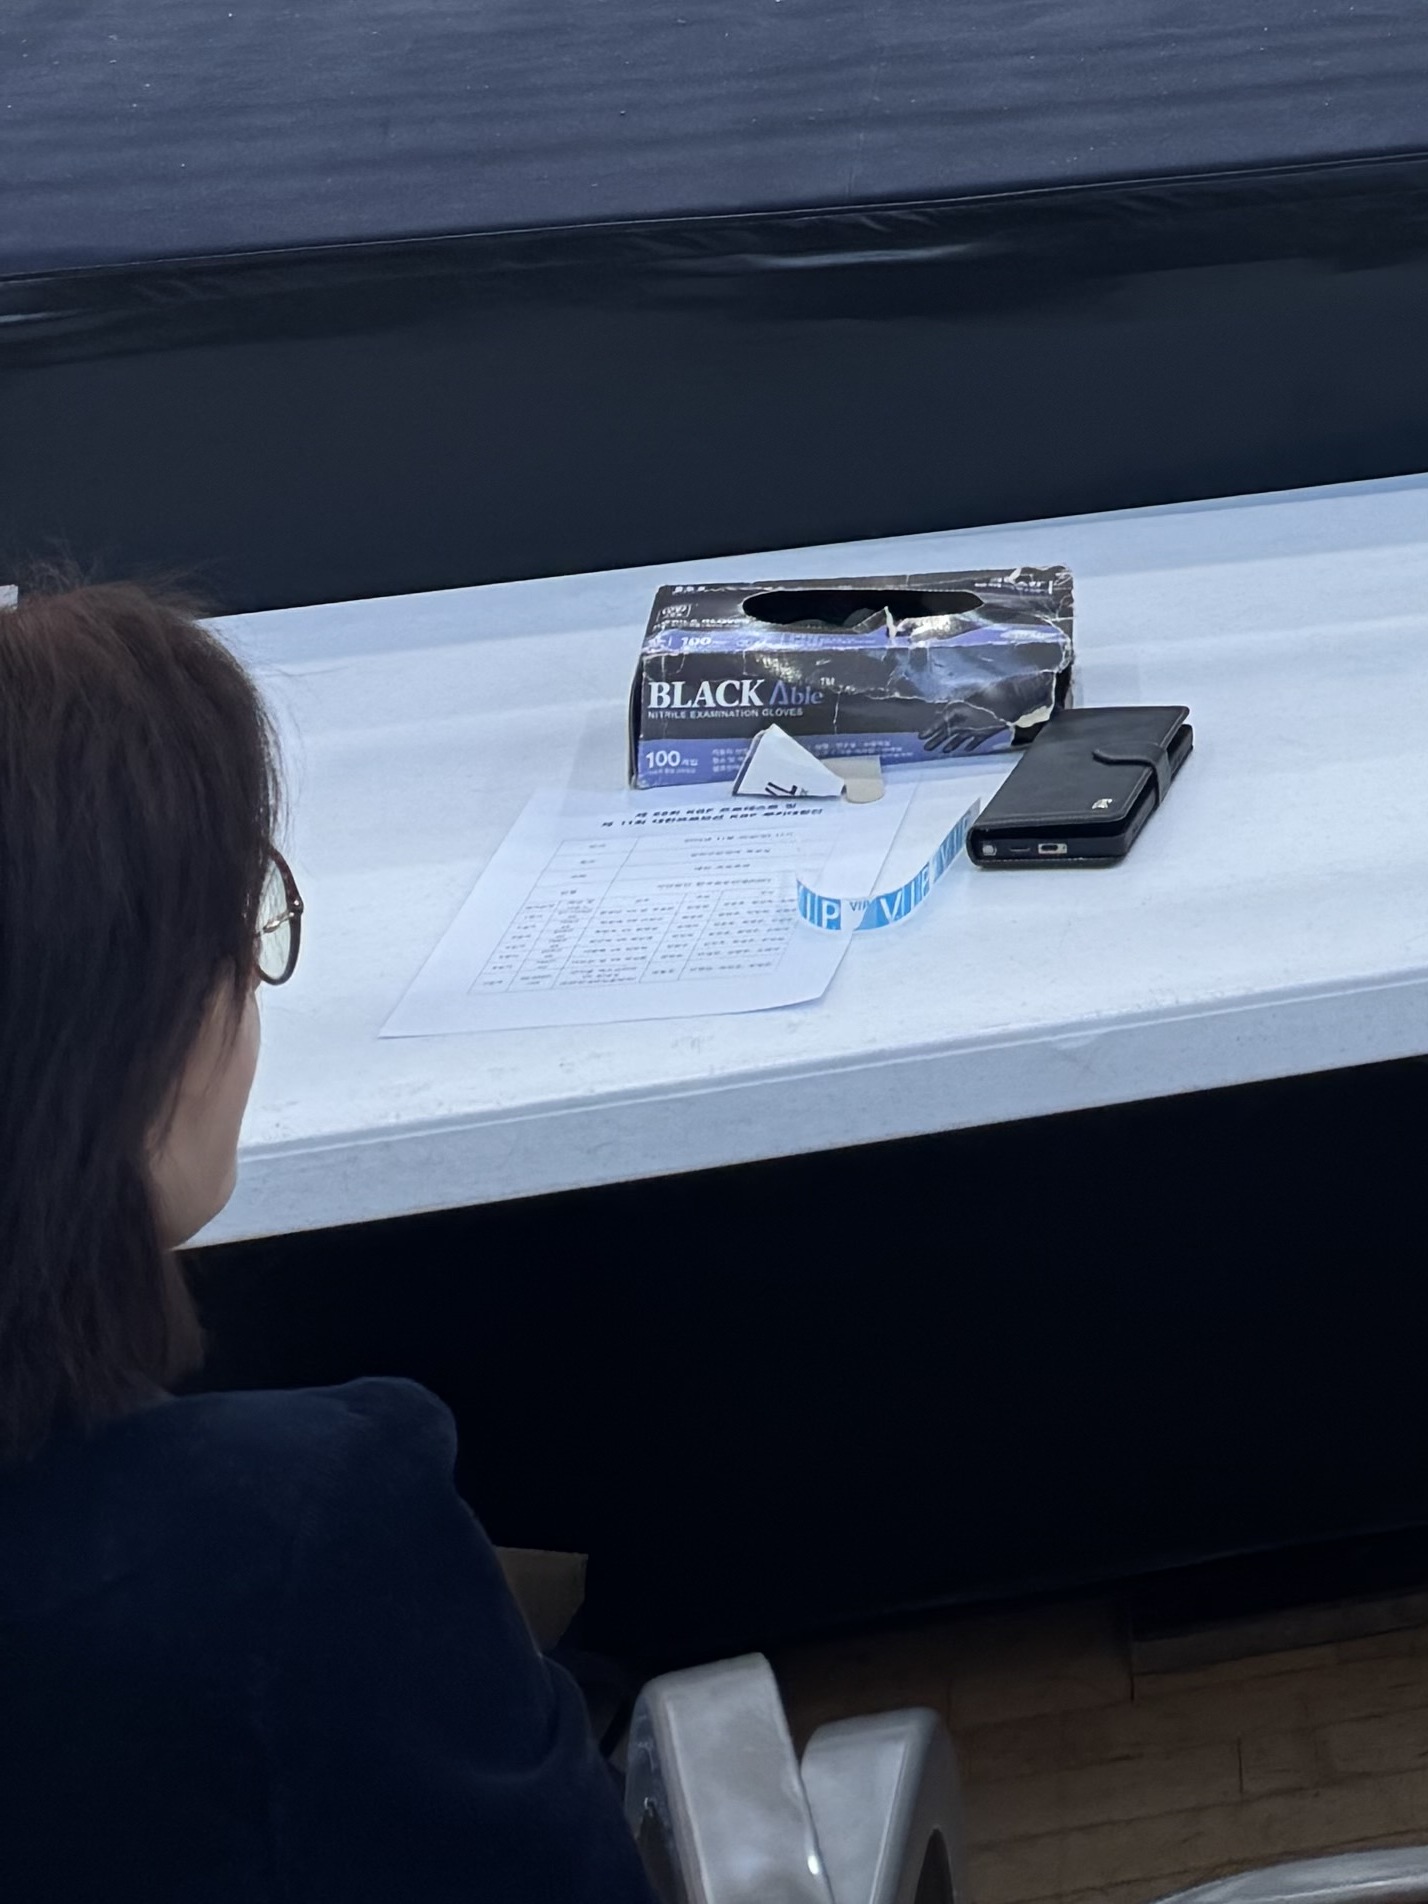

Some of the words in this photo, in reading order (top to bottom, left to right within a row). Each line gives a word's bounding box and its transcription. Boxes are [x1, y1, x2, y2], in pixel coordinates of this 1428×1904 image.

[647, 678, 765, 709] BLACK
[769, 679, 825, 706] Able
[648, 710, 686, 719] NITRILE
[690, 708, 759, 719] EXAMINATION
[762, 707, 803, 717] GLOVES
